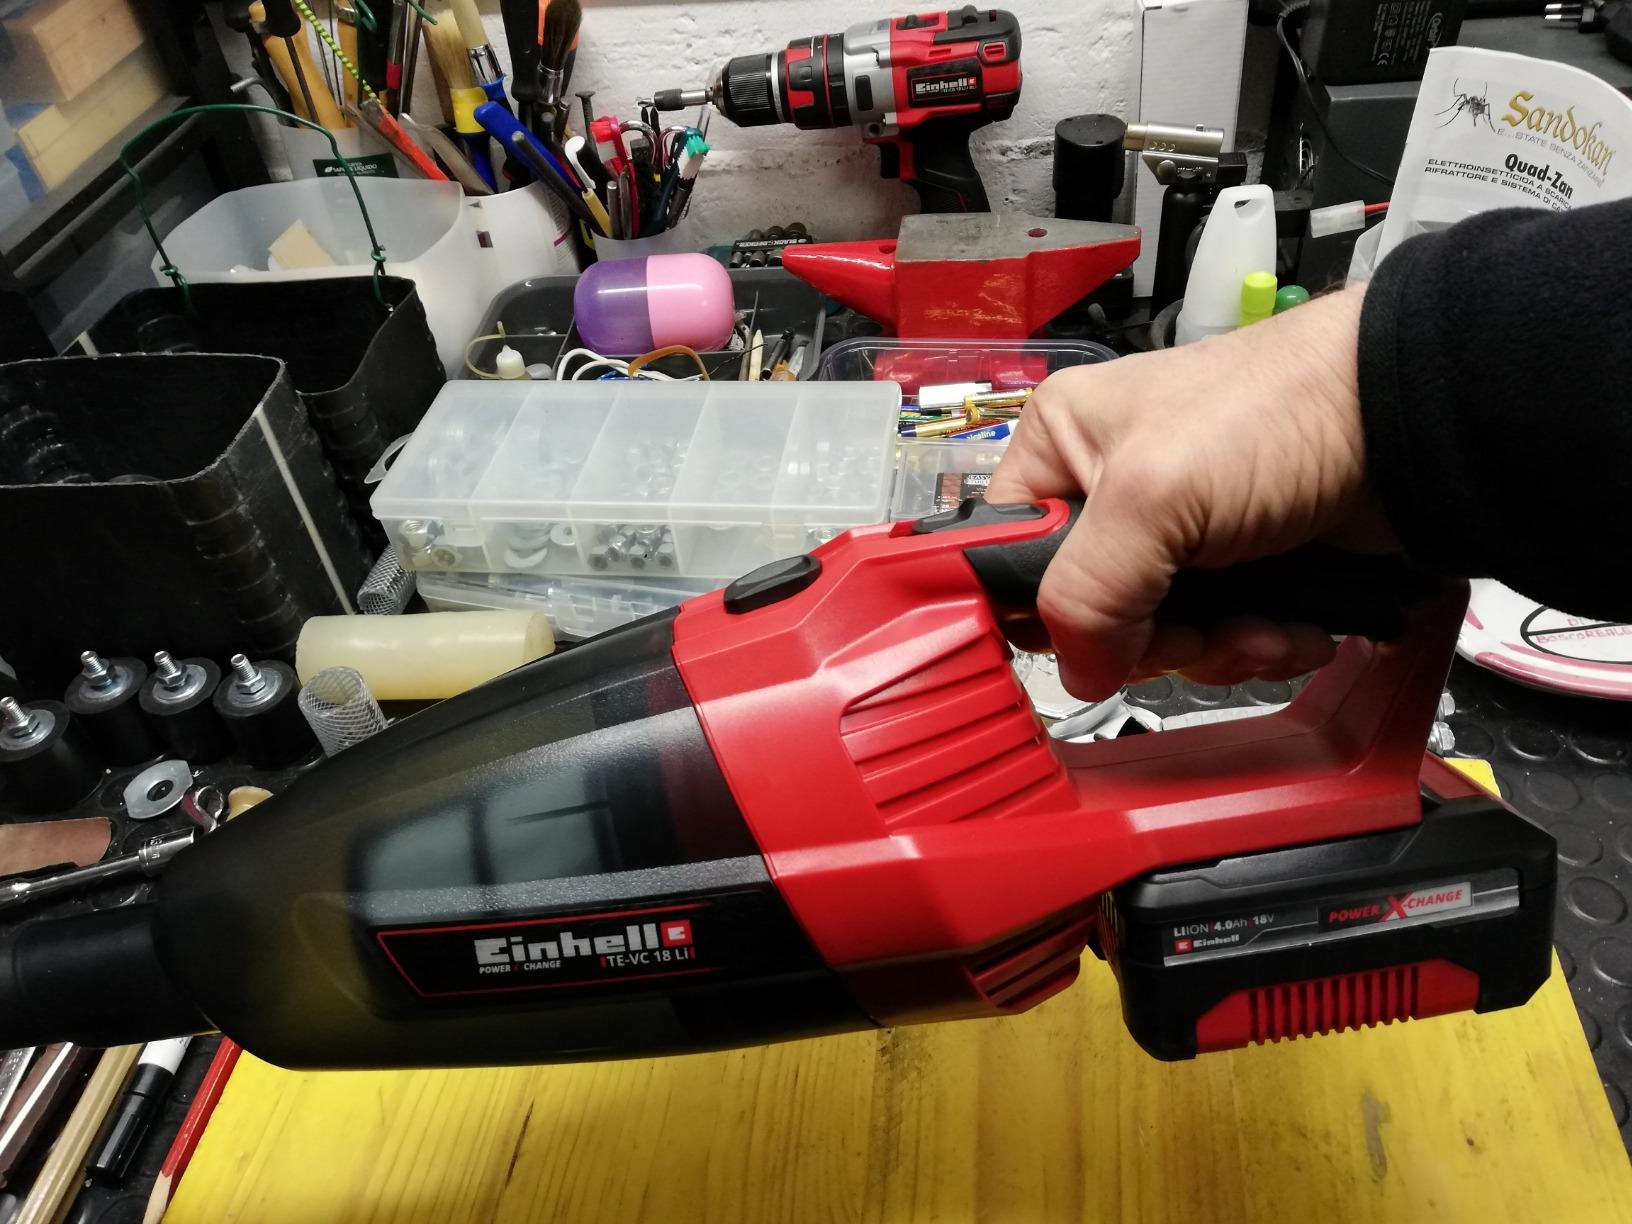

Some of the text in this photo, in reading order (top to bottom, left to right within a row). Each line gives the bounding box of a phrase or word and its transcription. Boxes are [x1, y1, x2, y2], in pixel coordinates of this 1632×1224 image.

[915, 78, 968, 95] Einhell
[1501, 90, 1614, 177] Sandokan
[1424, 166, 1489, 182] RIFRATTORE
[1501, 179, 1541, 200] SISTEMA
[1543, 195, 1551, 205] DI
[1427, 158, 1535, 188] ELETTROINSETTICIDA
[1536, 183, 1544, 192] A
[1505, 153, 1574, 200] Quad-Zan
[1328, 904, 1379, 923] POWER
[474, 923, 660, 965] Einhell
[1193, 934, 1240, 947] Einhell
[479, 960, 561, 975] POWER CHANGE
[606, 947, 690, 968] TE-VC 18 Li
